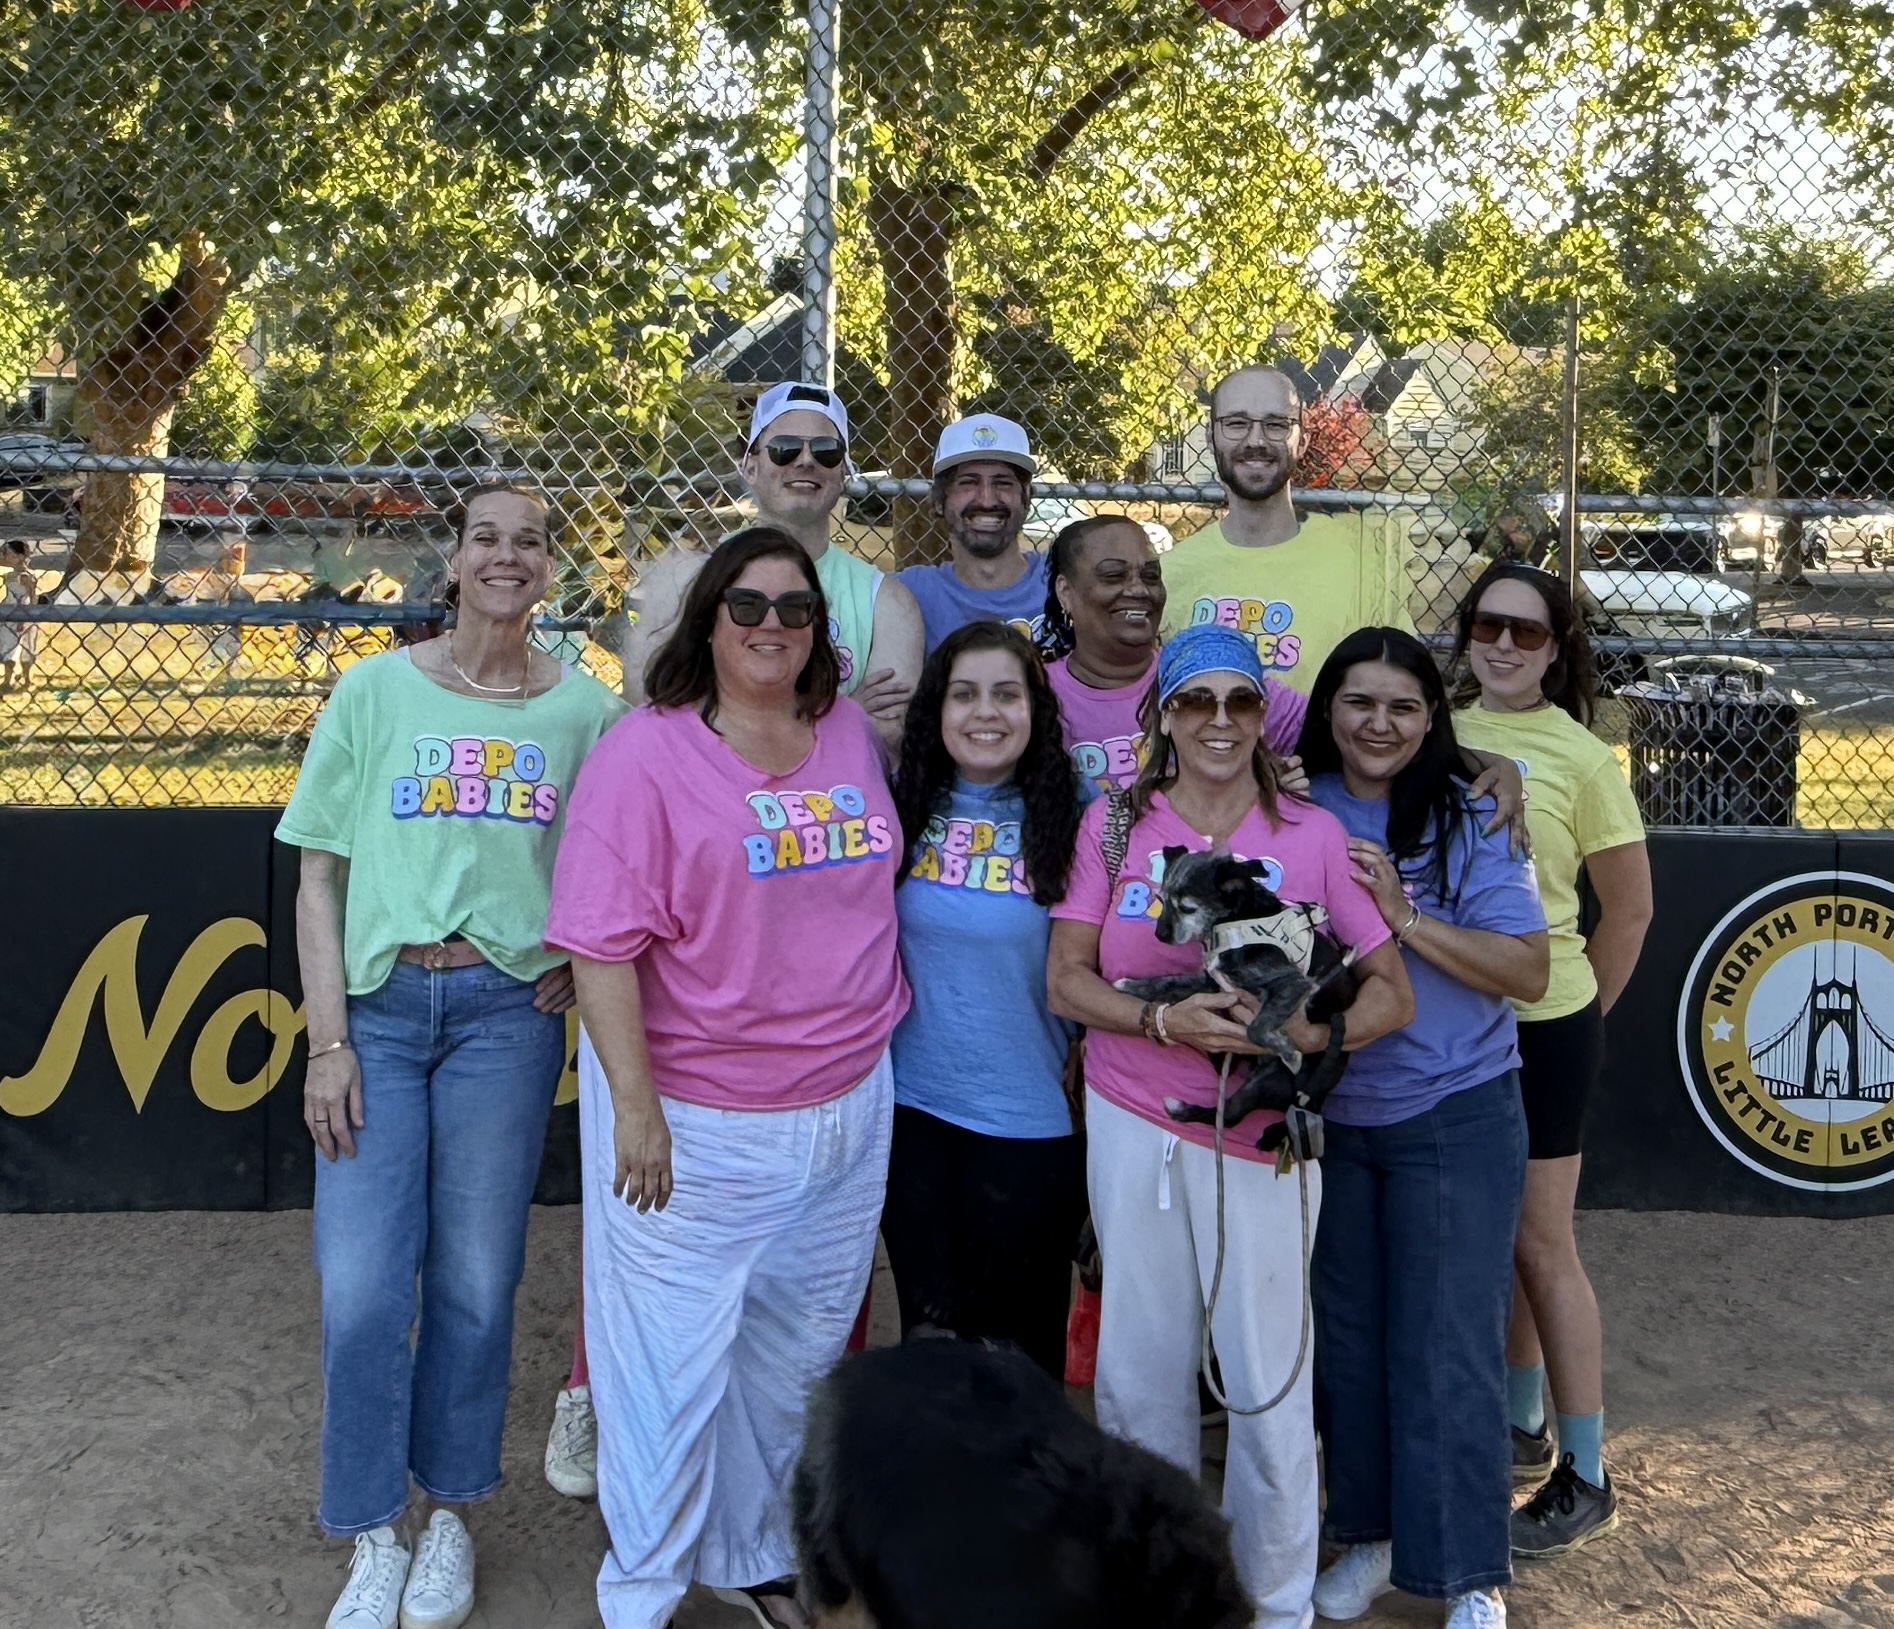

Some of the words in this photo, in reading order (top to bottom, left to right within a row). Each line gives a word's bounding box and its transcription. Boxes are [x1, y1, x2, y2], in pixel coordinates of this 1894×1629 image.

[1190, 596, 1294, 634] DEPO
[413, 735, 546, 783] DEPO
[391, 775, 559, 826] BABIES
[745, 785, 866, 830] DEPO
[742, 815, 893, 880] BABIES
[911, 844, 1032, 896] ABIES
[1710, 912, 1797, 1007] NORTH
[1713, 1061, 1814, 1153] LITTLE
